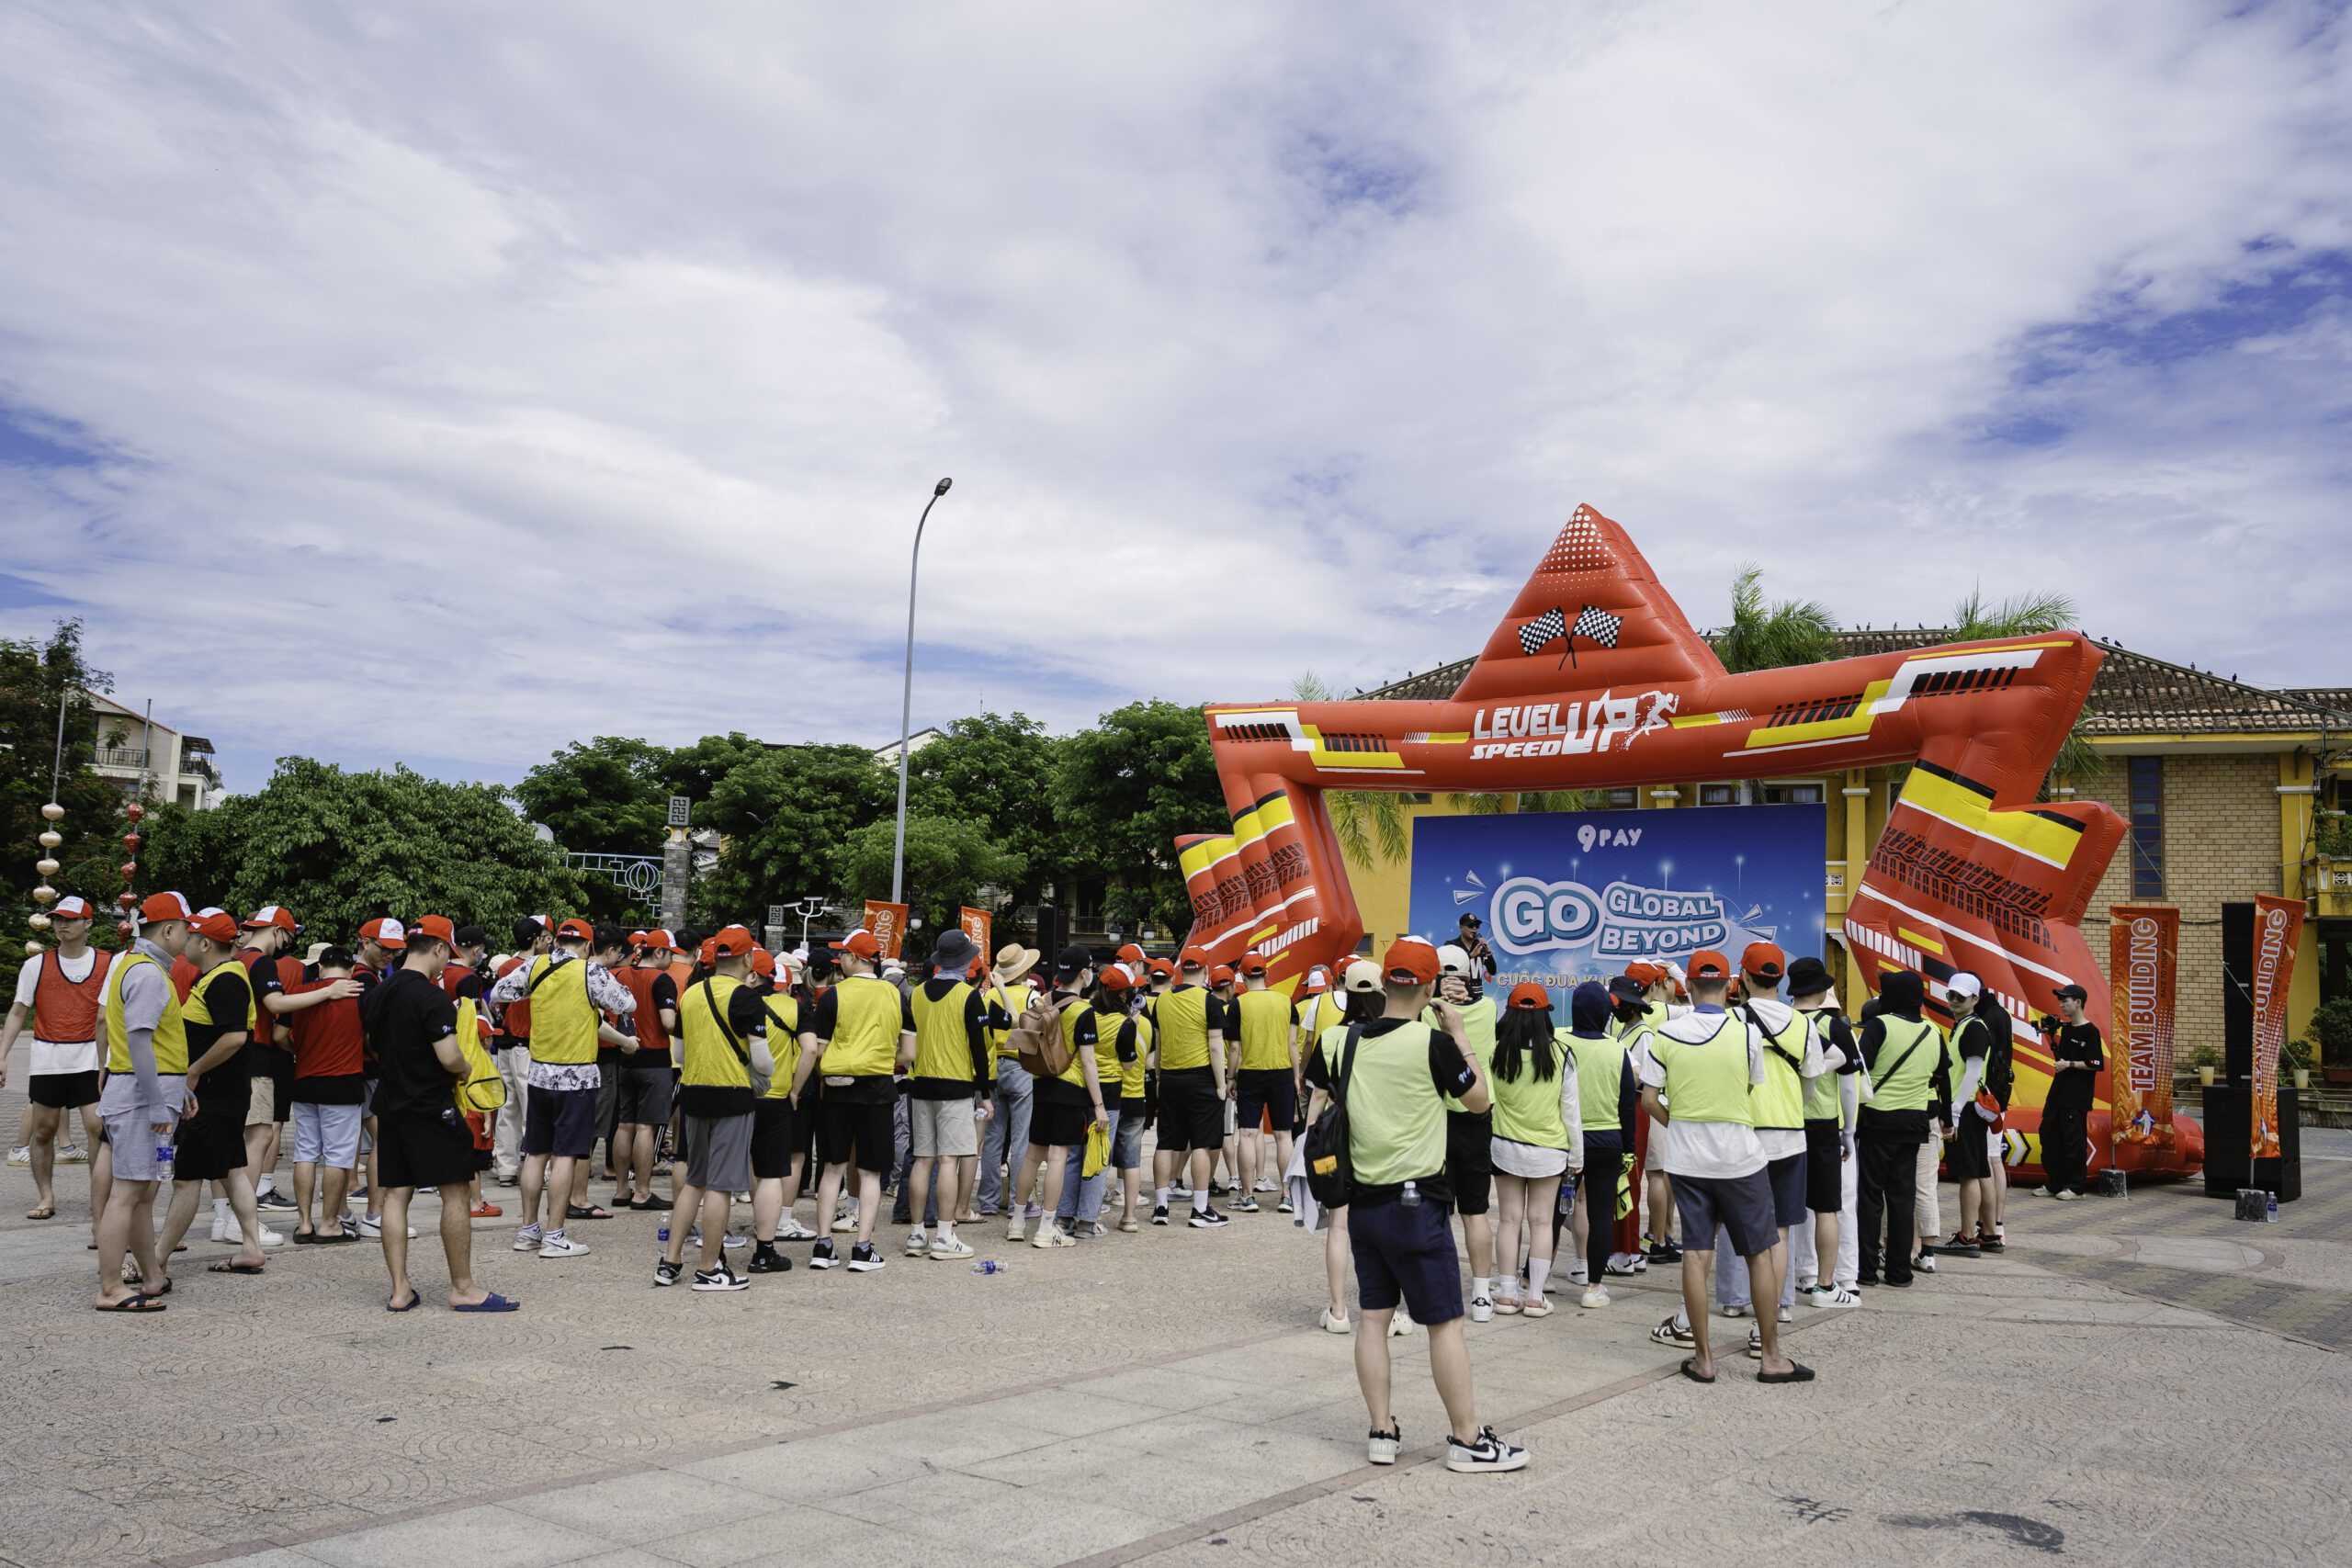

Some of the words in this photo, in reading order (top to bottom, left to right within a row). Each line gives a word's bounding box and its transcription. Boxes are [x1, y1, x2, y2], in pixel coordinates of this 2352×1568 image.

[1474, 703, 1566, 740] LEVEL
[1562, 689, 1639, 754] UP
[1470, 740, 1562, 760] SPEED
[1503, 889, 1594, 939] GO
[1609, 888, 1716, 919] GLOBAL
[1601, 923, 1723, 952] BEYOND
[2130, 917, 2159, 1028] BUILDING
[2160, 970, 2167, 978] TO
[2256, 908, 2288, 1026] BUILDING
[2129, 1030, 2155, 1093] TEAM
